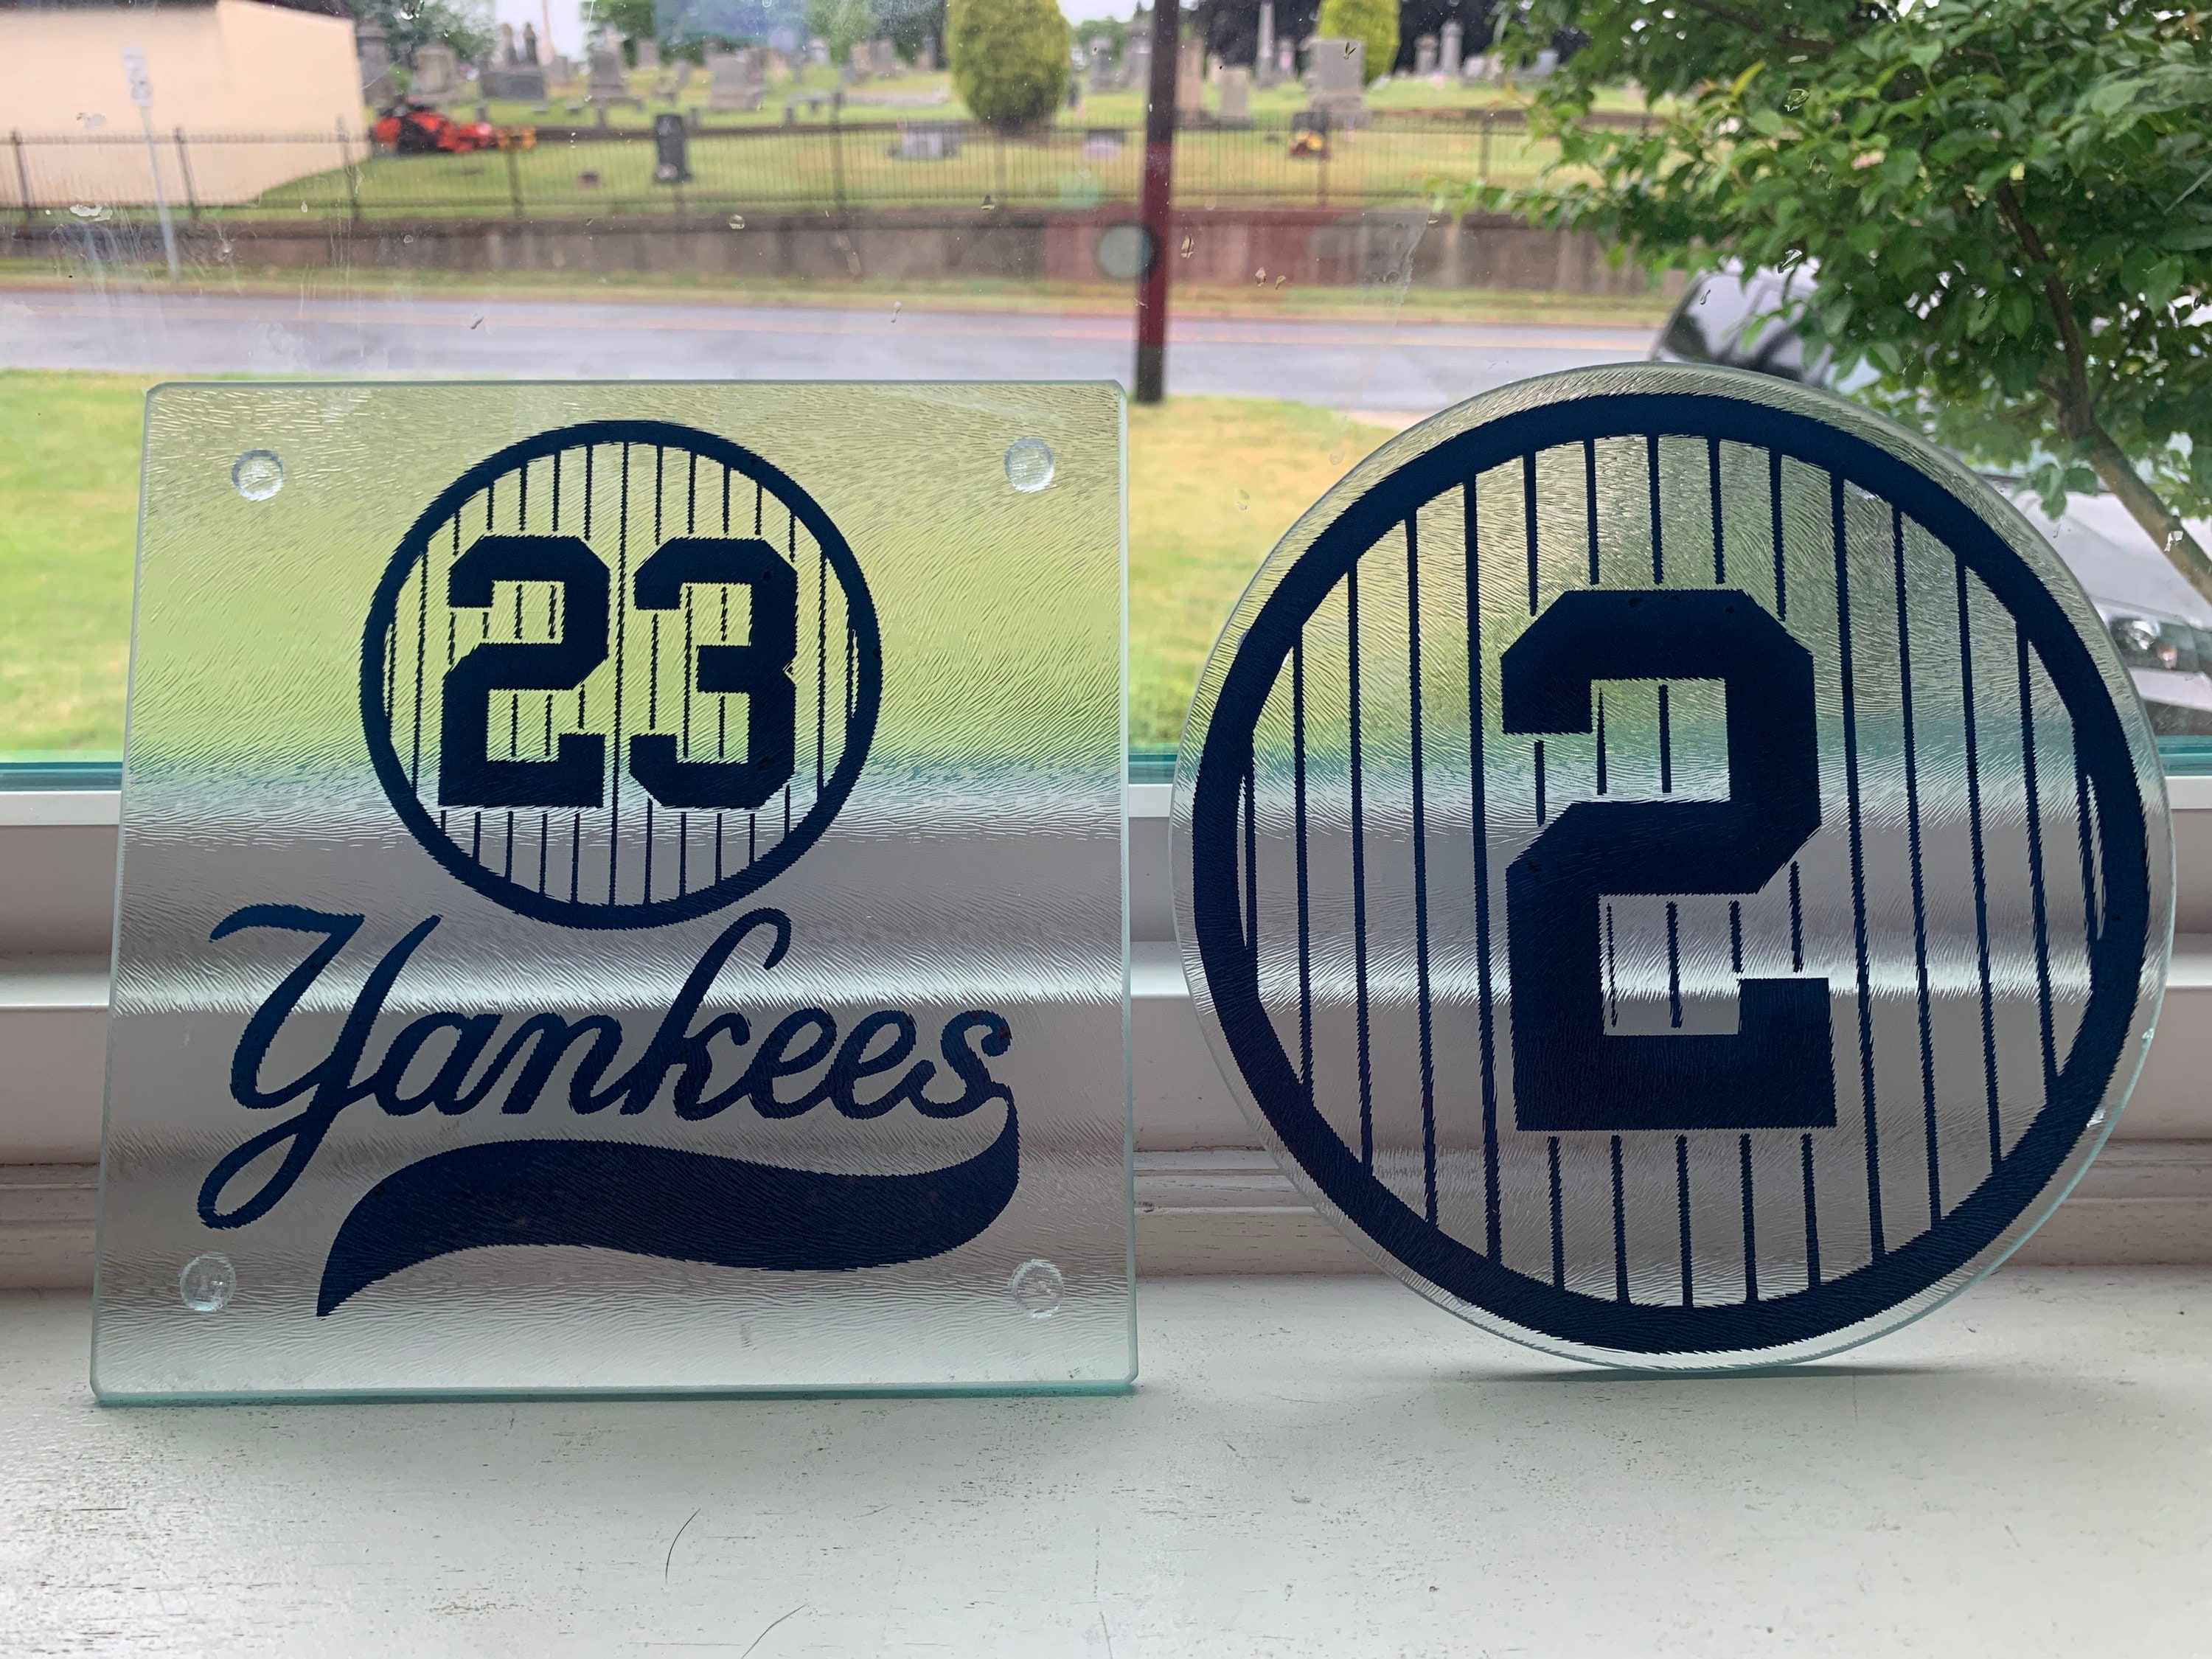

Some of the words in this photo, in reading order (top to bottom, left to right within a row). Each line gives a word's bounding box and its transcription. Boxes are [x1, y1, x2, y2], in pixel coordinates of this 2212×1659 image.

[438, 535, 798, 810] 23
[1500, 588, 1837, 1131] 2
[196, 905, 1013, 1229] Yankees
